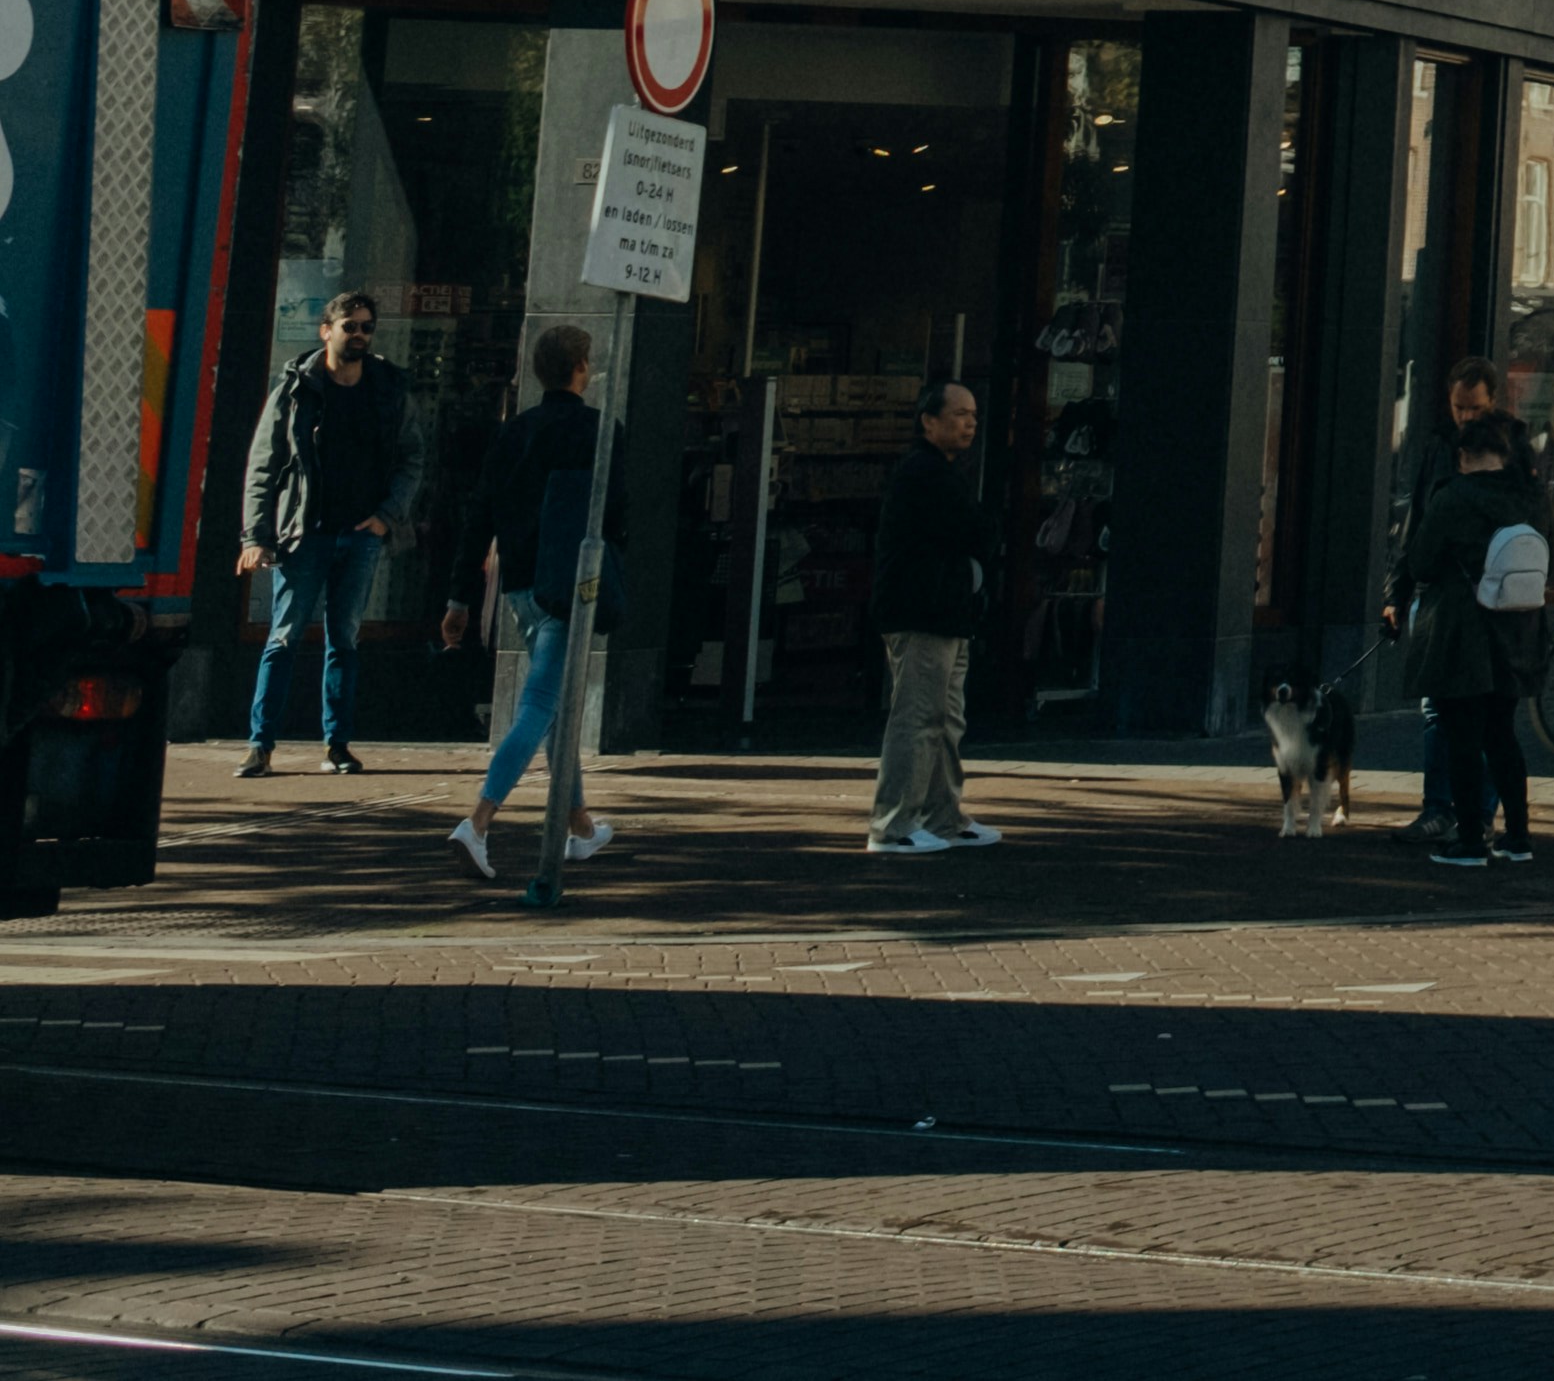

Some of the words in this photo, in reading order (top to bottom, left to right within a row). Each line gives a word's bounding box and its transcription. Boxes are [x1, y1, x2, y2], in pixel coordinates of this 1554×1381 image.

[628, 121, 696, 153] Uitgezonderd
[623, 148, 692, 180] (snor)fietsers
[636, 180, 663, 199] 0-24
[665, 189, 674, 203] H
[604, 205, 618, 219] en
[621, 205, 653, 226] laden
[662, 215, 694, 237] lossen
[619, 237, 636, 252] ma
[640, 239, 659, 257] t/m
[662, 246, 674, 259] za
[625, 264, 649, 283] 9-12
[654, 269, 662, 285] H
